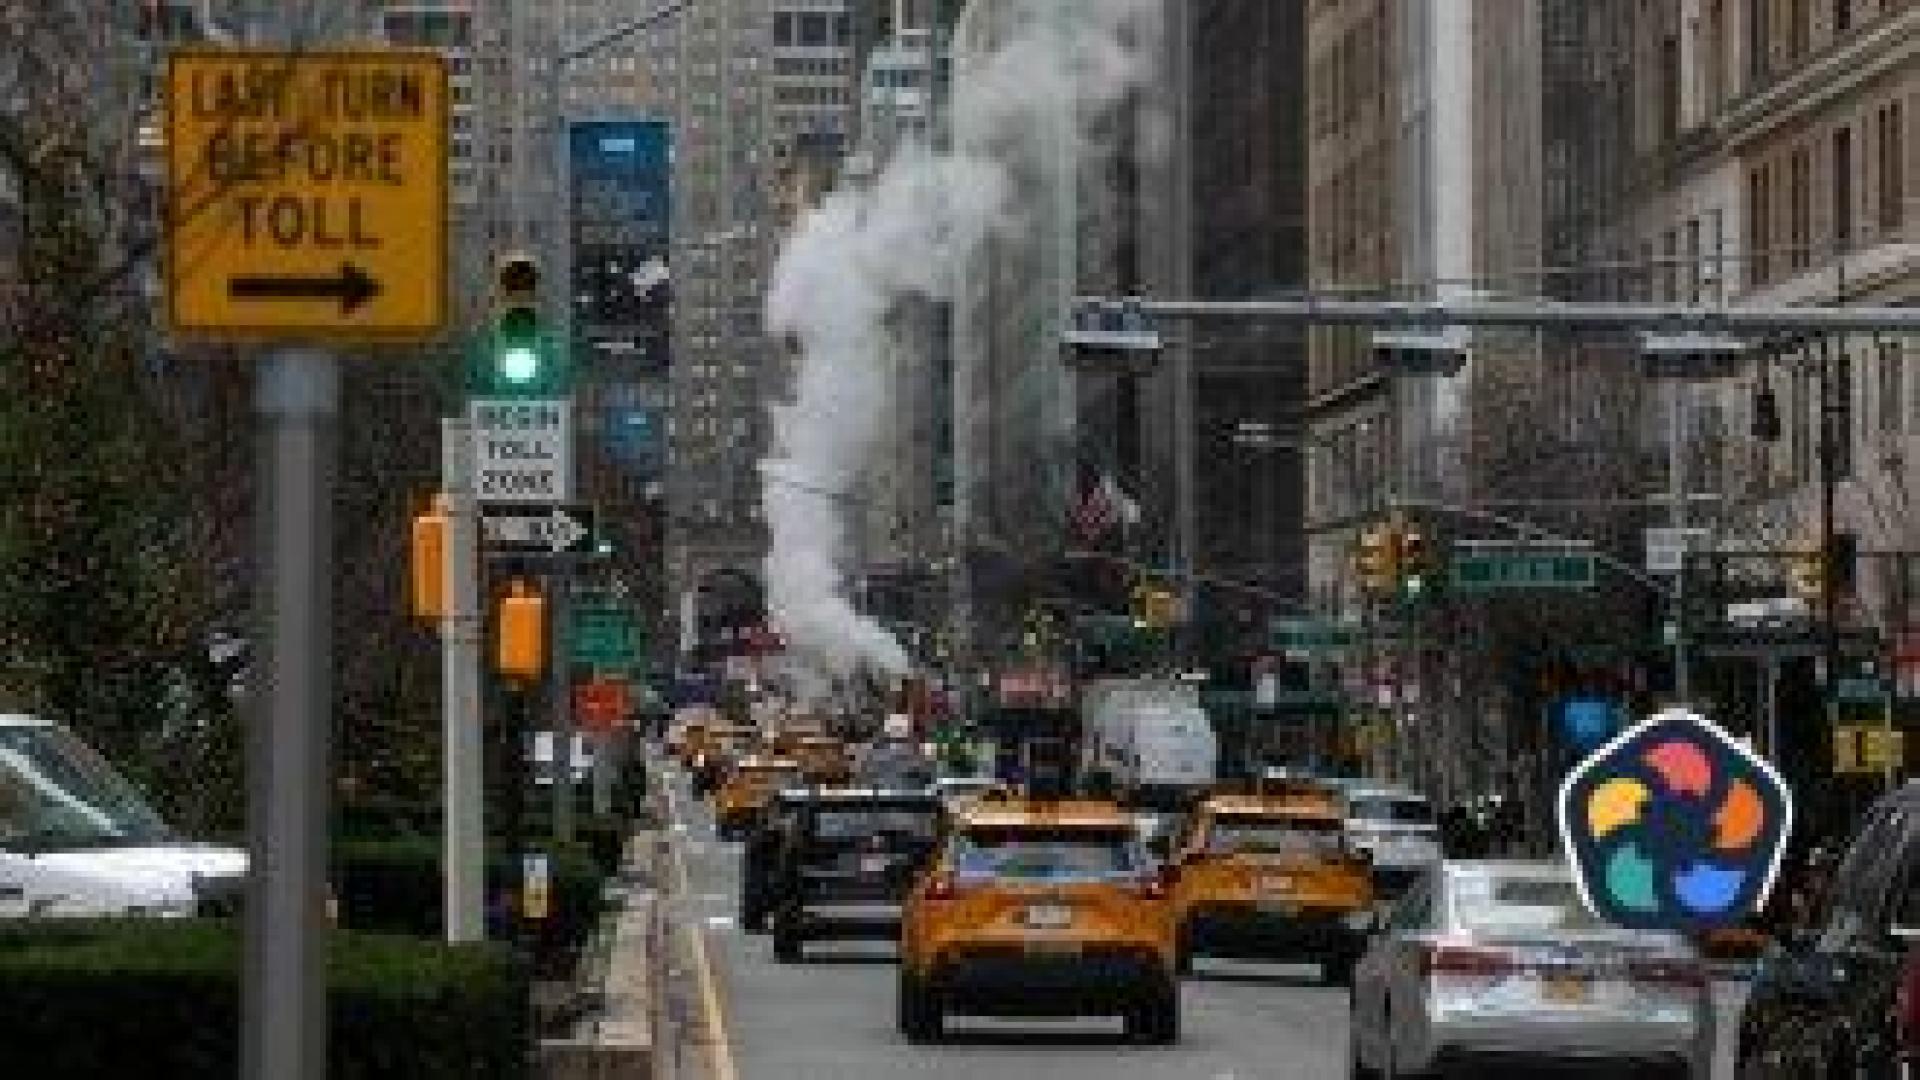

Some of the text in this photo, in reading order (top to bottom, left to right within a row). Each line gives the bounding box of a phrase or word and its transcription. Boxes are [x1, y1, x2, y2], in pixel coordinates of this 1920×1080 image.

[190, 69, 423, 118] LAST TURN
[208, 131, 402, 183] BEFORE
[236, 197, 382, 248] TOLL
[486, 440, 553, 459] TOLL
[481, 470, 554, 494] ZONE
